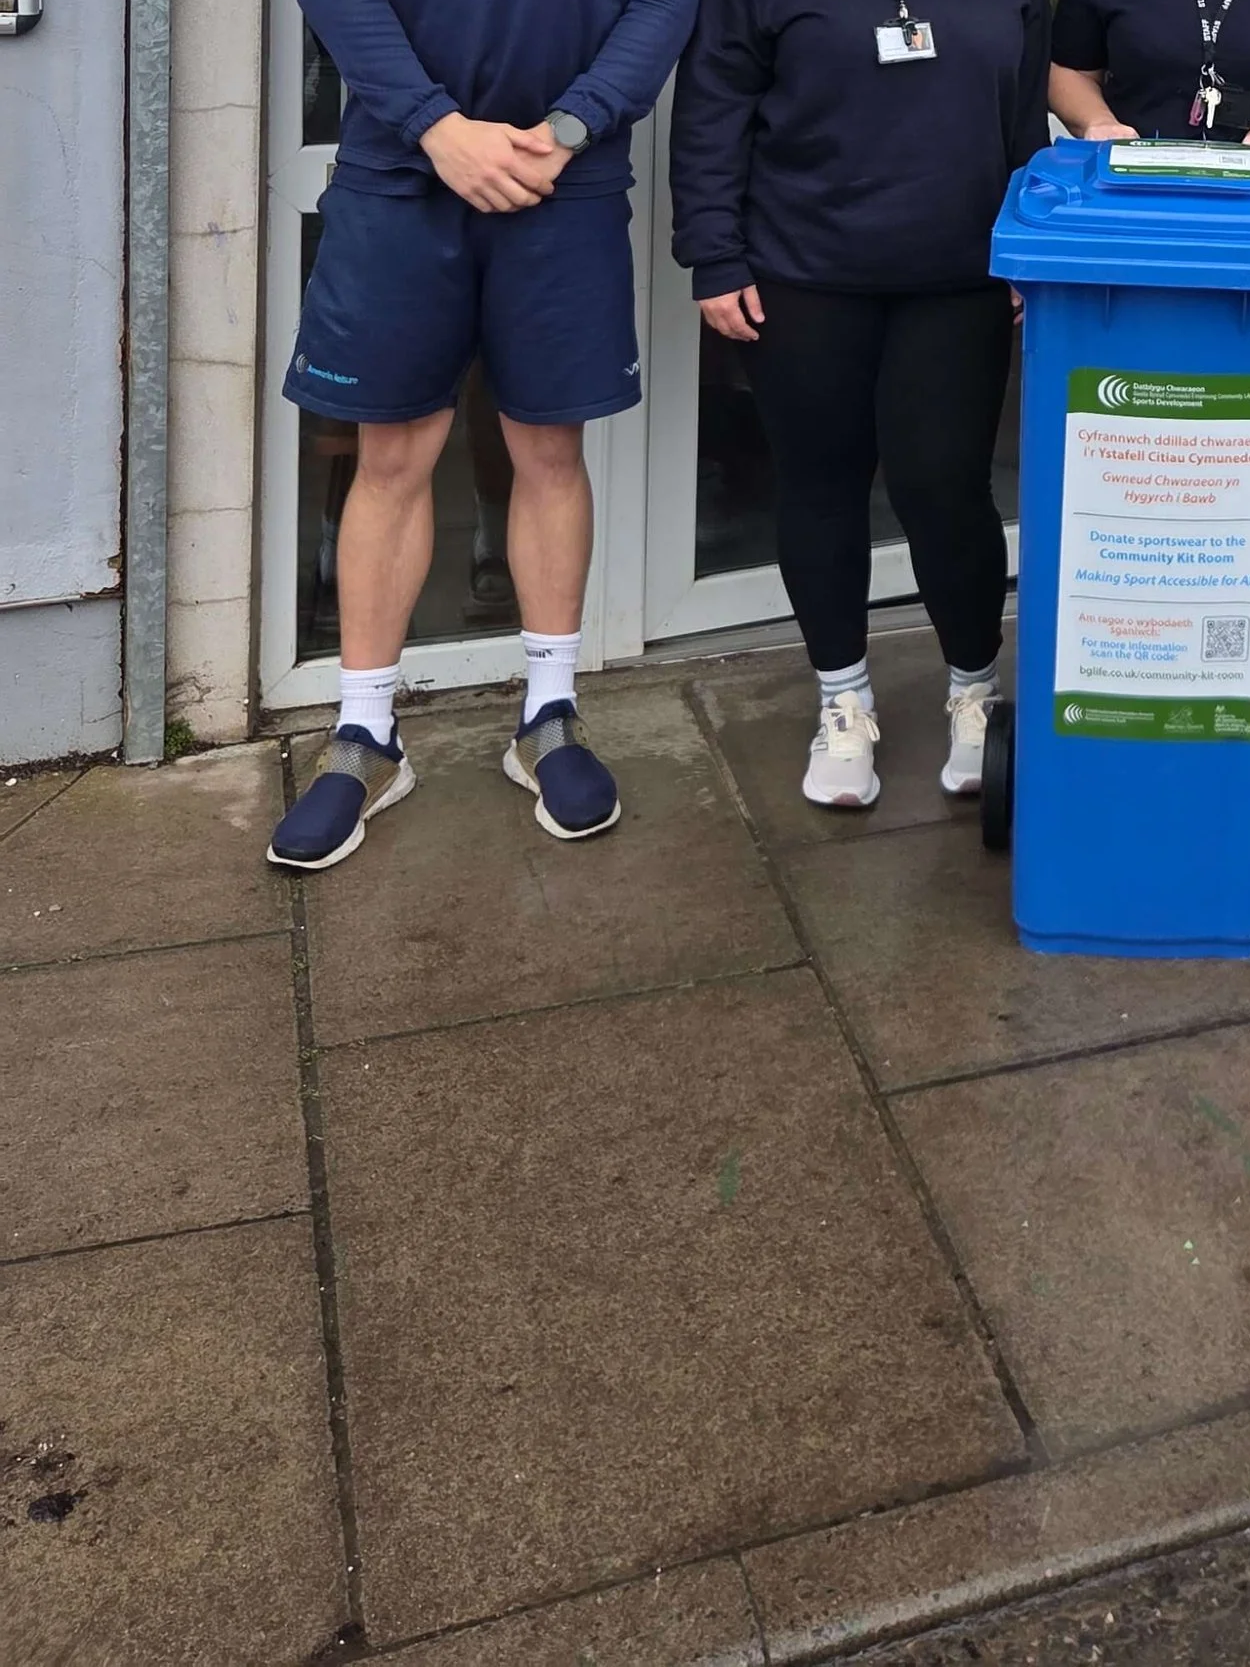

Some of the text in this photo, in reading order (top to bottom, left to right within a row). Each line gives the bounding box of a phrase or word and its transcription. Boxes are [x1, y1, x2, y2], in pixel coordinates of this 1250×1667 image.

[1132, 397, 1203, 408] Sports Development
[1078, 429, 1150, 446] Cyfrannwch
[1154, 433, 1197, 447] ddillad
[1099, 447, 1145, 461] Ystafell
[1148, 451, 1185, 463] Citiau
[1102, 471, 1240, 490] Gwneud Chwaraeon yn
[1124, 490, 1173, 505] Hygyrch
[1182, 492, 1216, 504] Bawb
[1090, 530, 1246, 548] Donate sportswear to the
[1100, 548, 1235, 565] Community Kit Room
[1075, 569, 1120, 585] Making
[1123, 572, 1157, 587] Sport
[1158, 574, 1219, 587] Accessible
[1221, 574, 1237, 586] for
[1081, 637, 1188, 652] For more information
[1091, 649, 1113, 659] scan
[1115, 649, 1132, 660] the
[1134, 651, 1149, 662] QR
